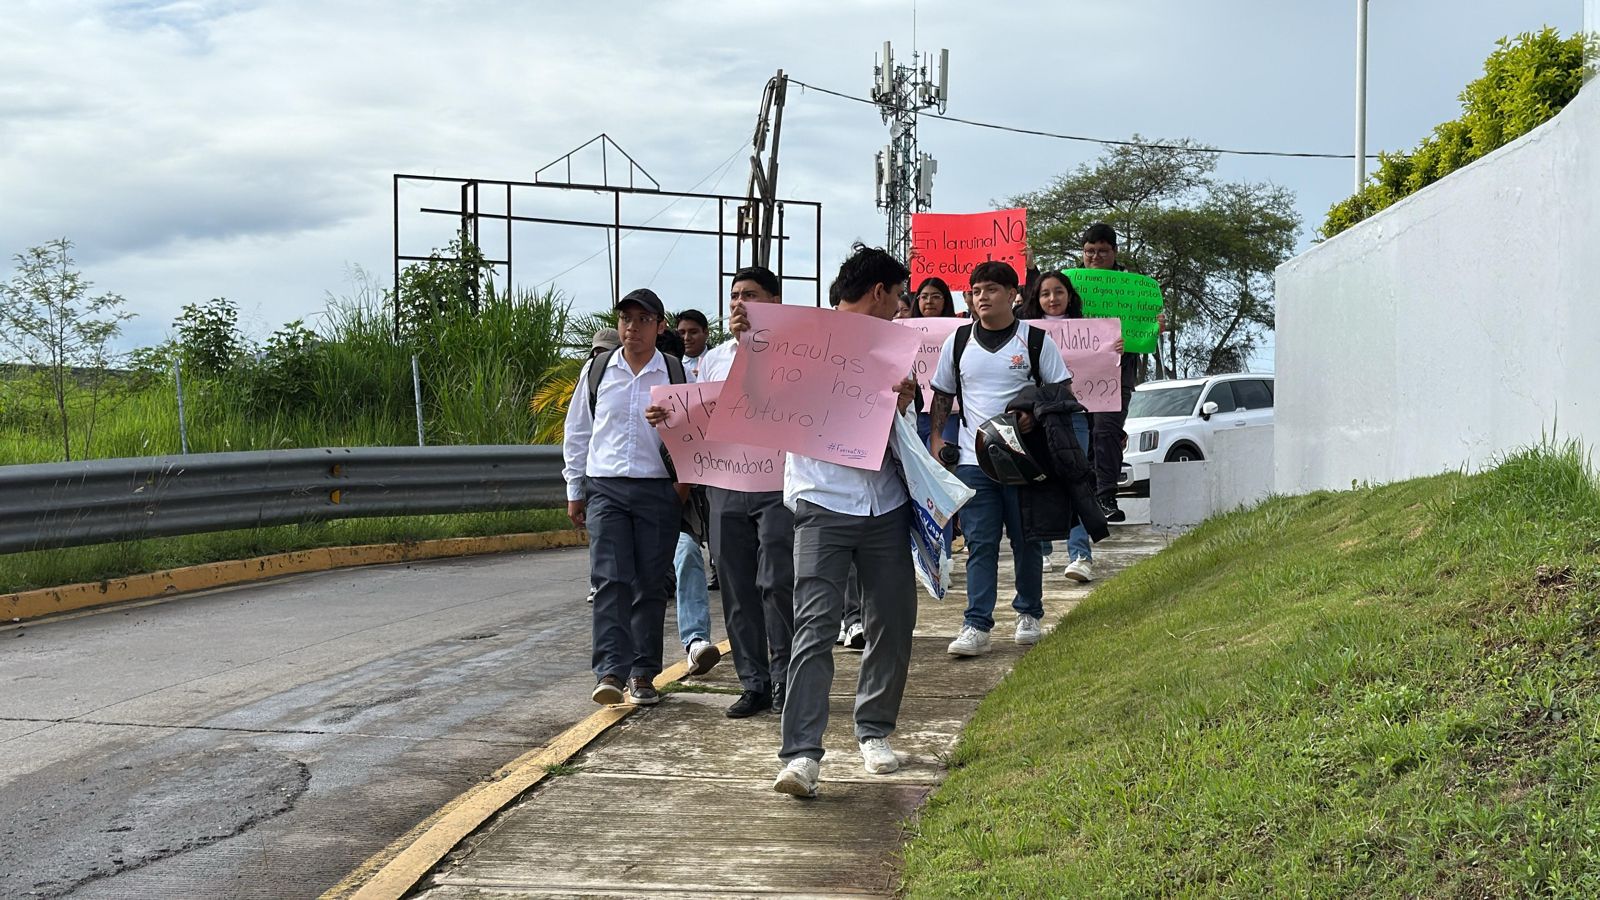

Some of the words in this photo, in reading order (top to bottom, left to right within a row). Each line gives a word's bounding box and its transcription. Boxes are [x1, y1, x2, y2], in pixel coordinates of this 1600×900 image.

[913, 231, 938, 250] En
[993, 216, 1025, 247] NO
[915, 255, 935, 274] Se
[1060, 320, 1101, 352] Nahle
[770, 366, 802, 383] no
[831, 373, 880, 419] hay
